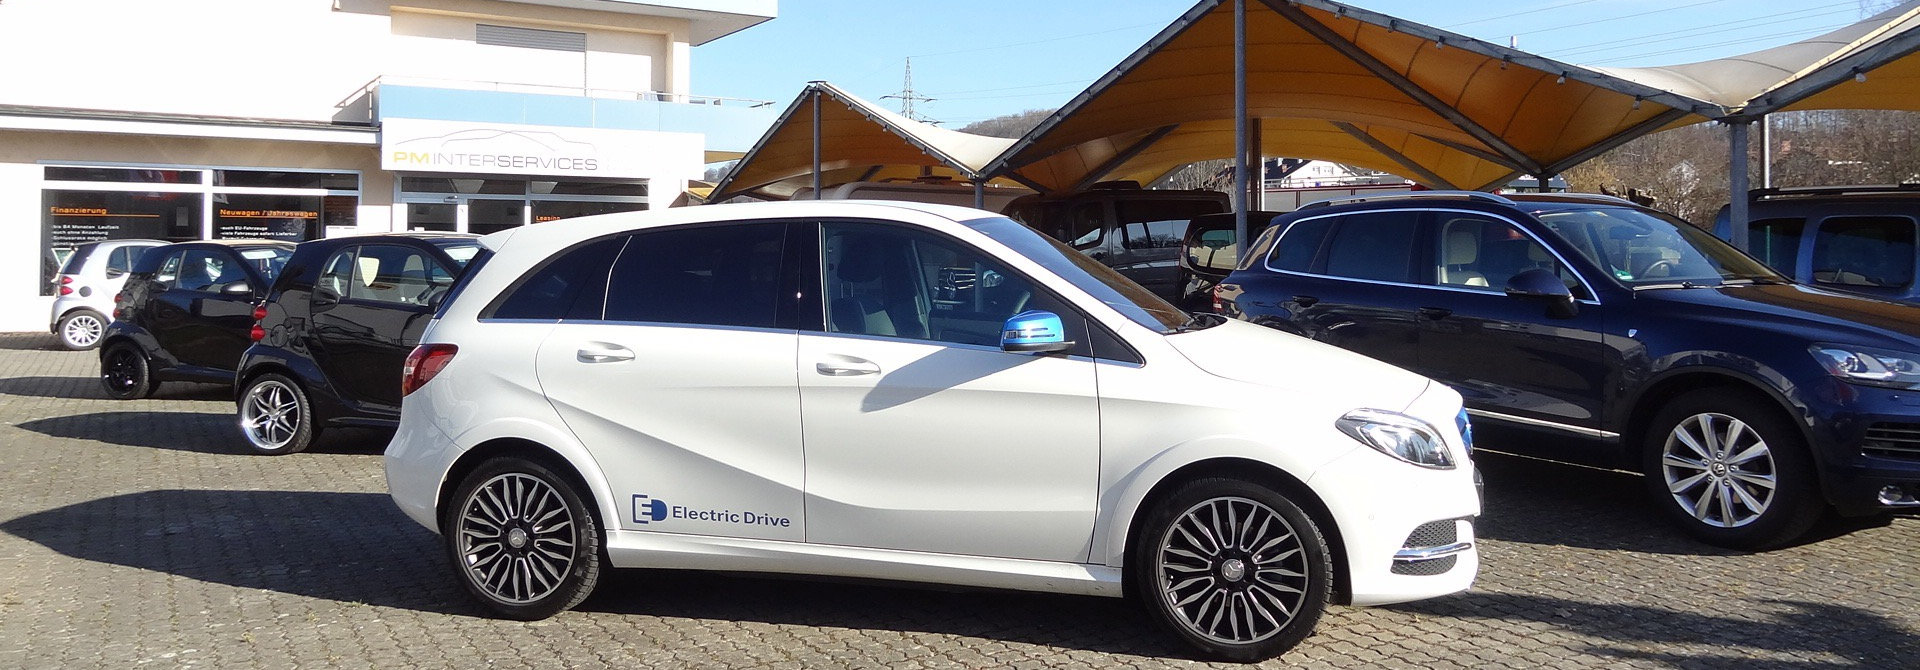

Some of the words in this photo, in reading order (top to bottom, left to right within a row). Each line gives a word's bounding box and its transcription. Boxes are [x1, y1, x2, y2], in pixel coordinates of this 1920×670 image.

[50, 206, 107, 215] Finanzierung
[267, 210, 318, 218] Jahreswagen
[672, 505, 740, 523] Electric
[743, 511, 790, 527] Drive
